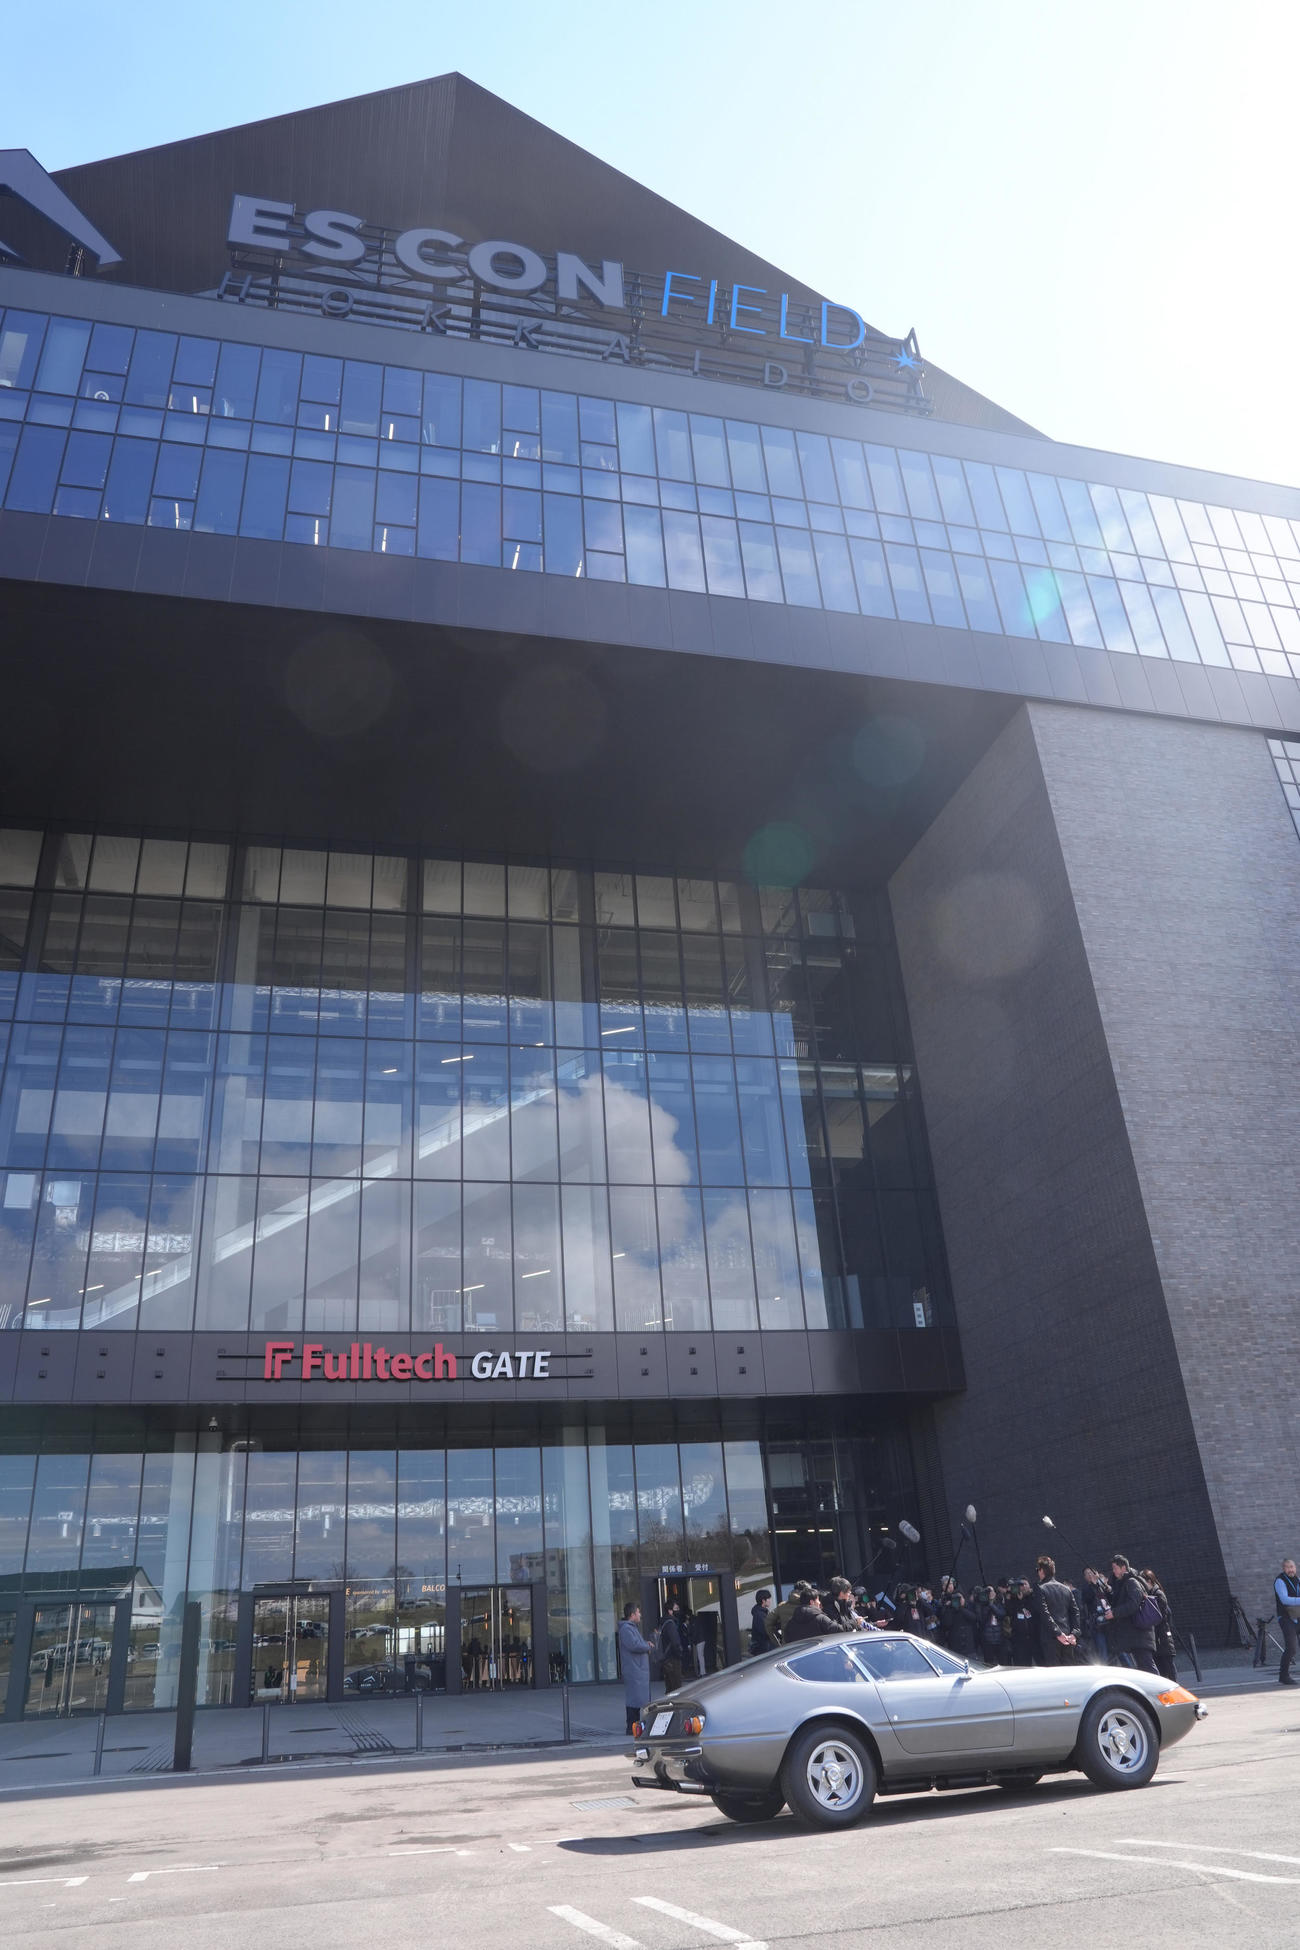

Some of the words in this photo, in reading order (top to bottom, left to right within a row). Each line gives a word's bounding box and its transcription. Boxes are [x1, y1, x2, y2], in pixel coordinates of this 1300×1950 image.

[217, 271, 875, 402] HOKKAIDO
[661, 271, 866, 350] FIELD
[302, 1342, 457, 1380] Fulltech
[471, 1351, 551, 1379] GATE
